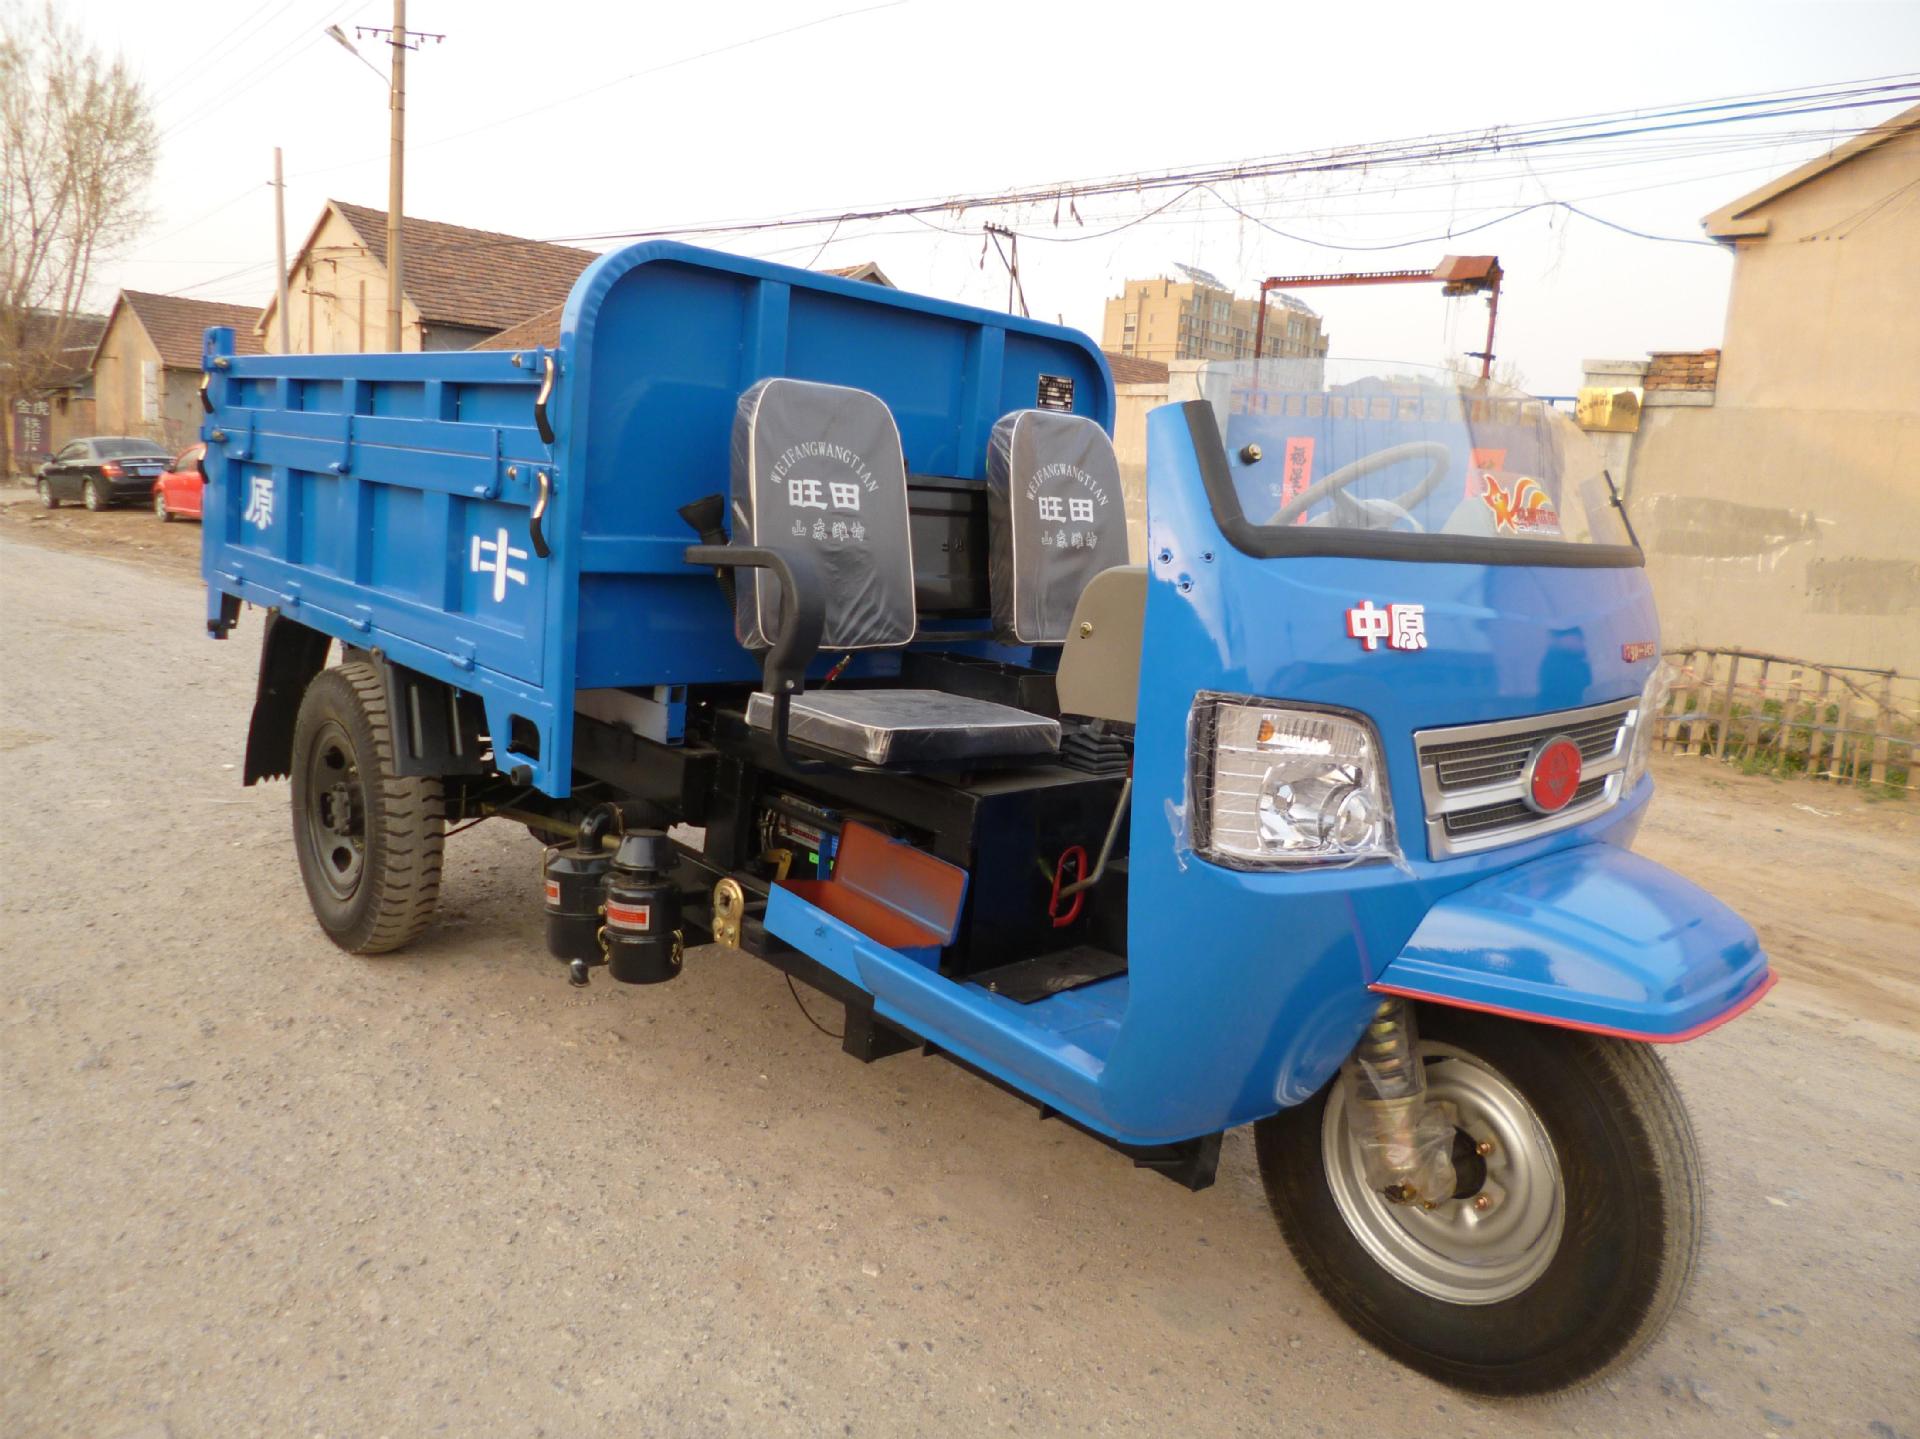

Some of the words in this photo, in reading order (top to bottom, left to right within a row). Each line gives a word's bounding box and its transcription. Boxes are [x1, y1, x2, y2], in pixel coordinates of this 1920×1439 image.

[770, 441, 879, 492] WEIFANGWANGTIAN
[1026, 463, 1109, 506] WEIFANGWANGTIAN
[245, 476, 273, 530] 原
[788, 479, 860, 511] 旺田
[1038, 496, 1094, 523] 旺田
[471, 527, 528, 602] 中
[1346, 600, 1428, 651] 中原
